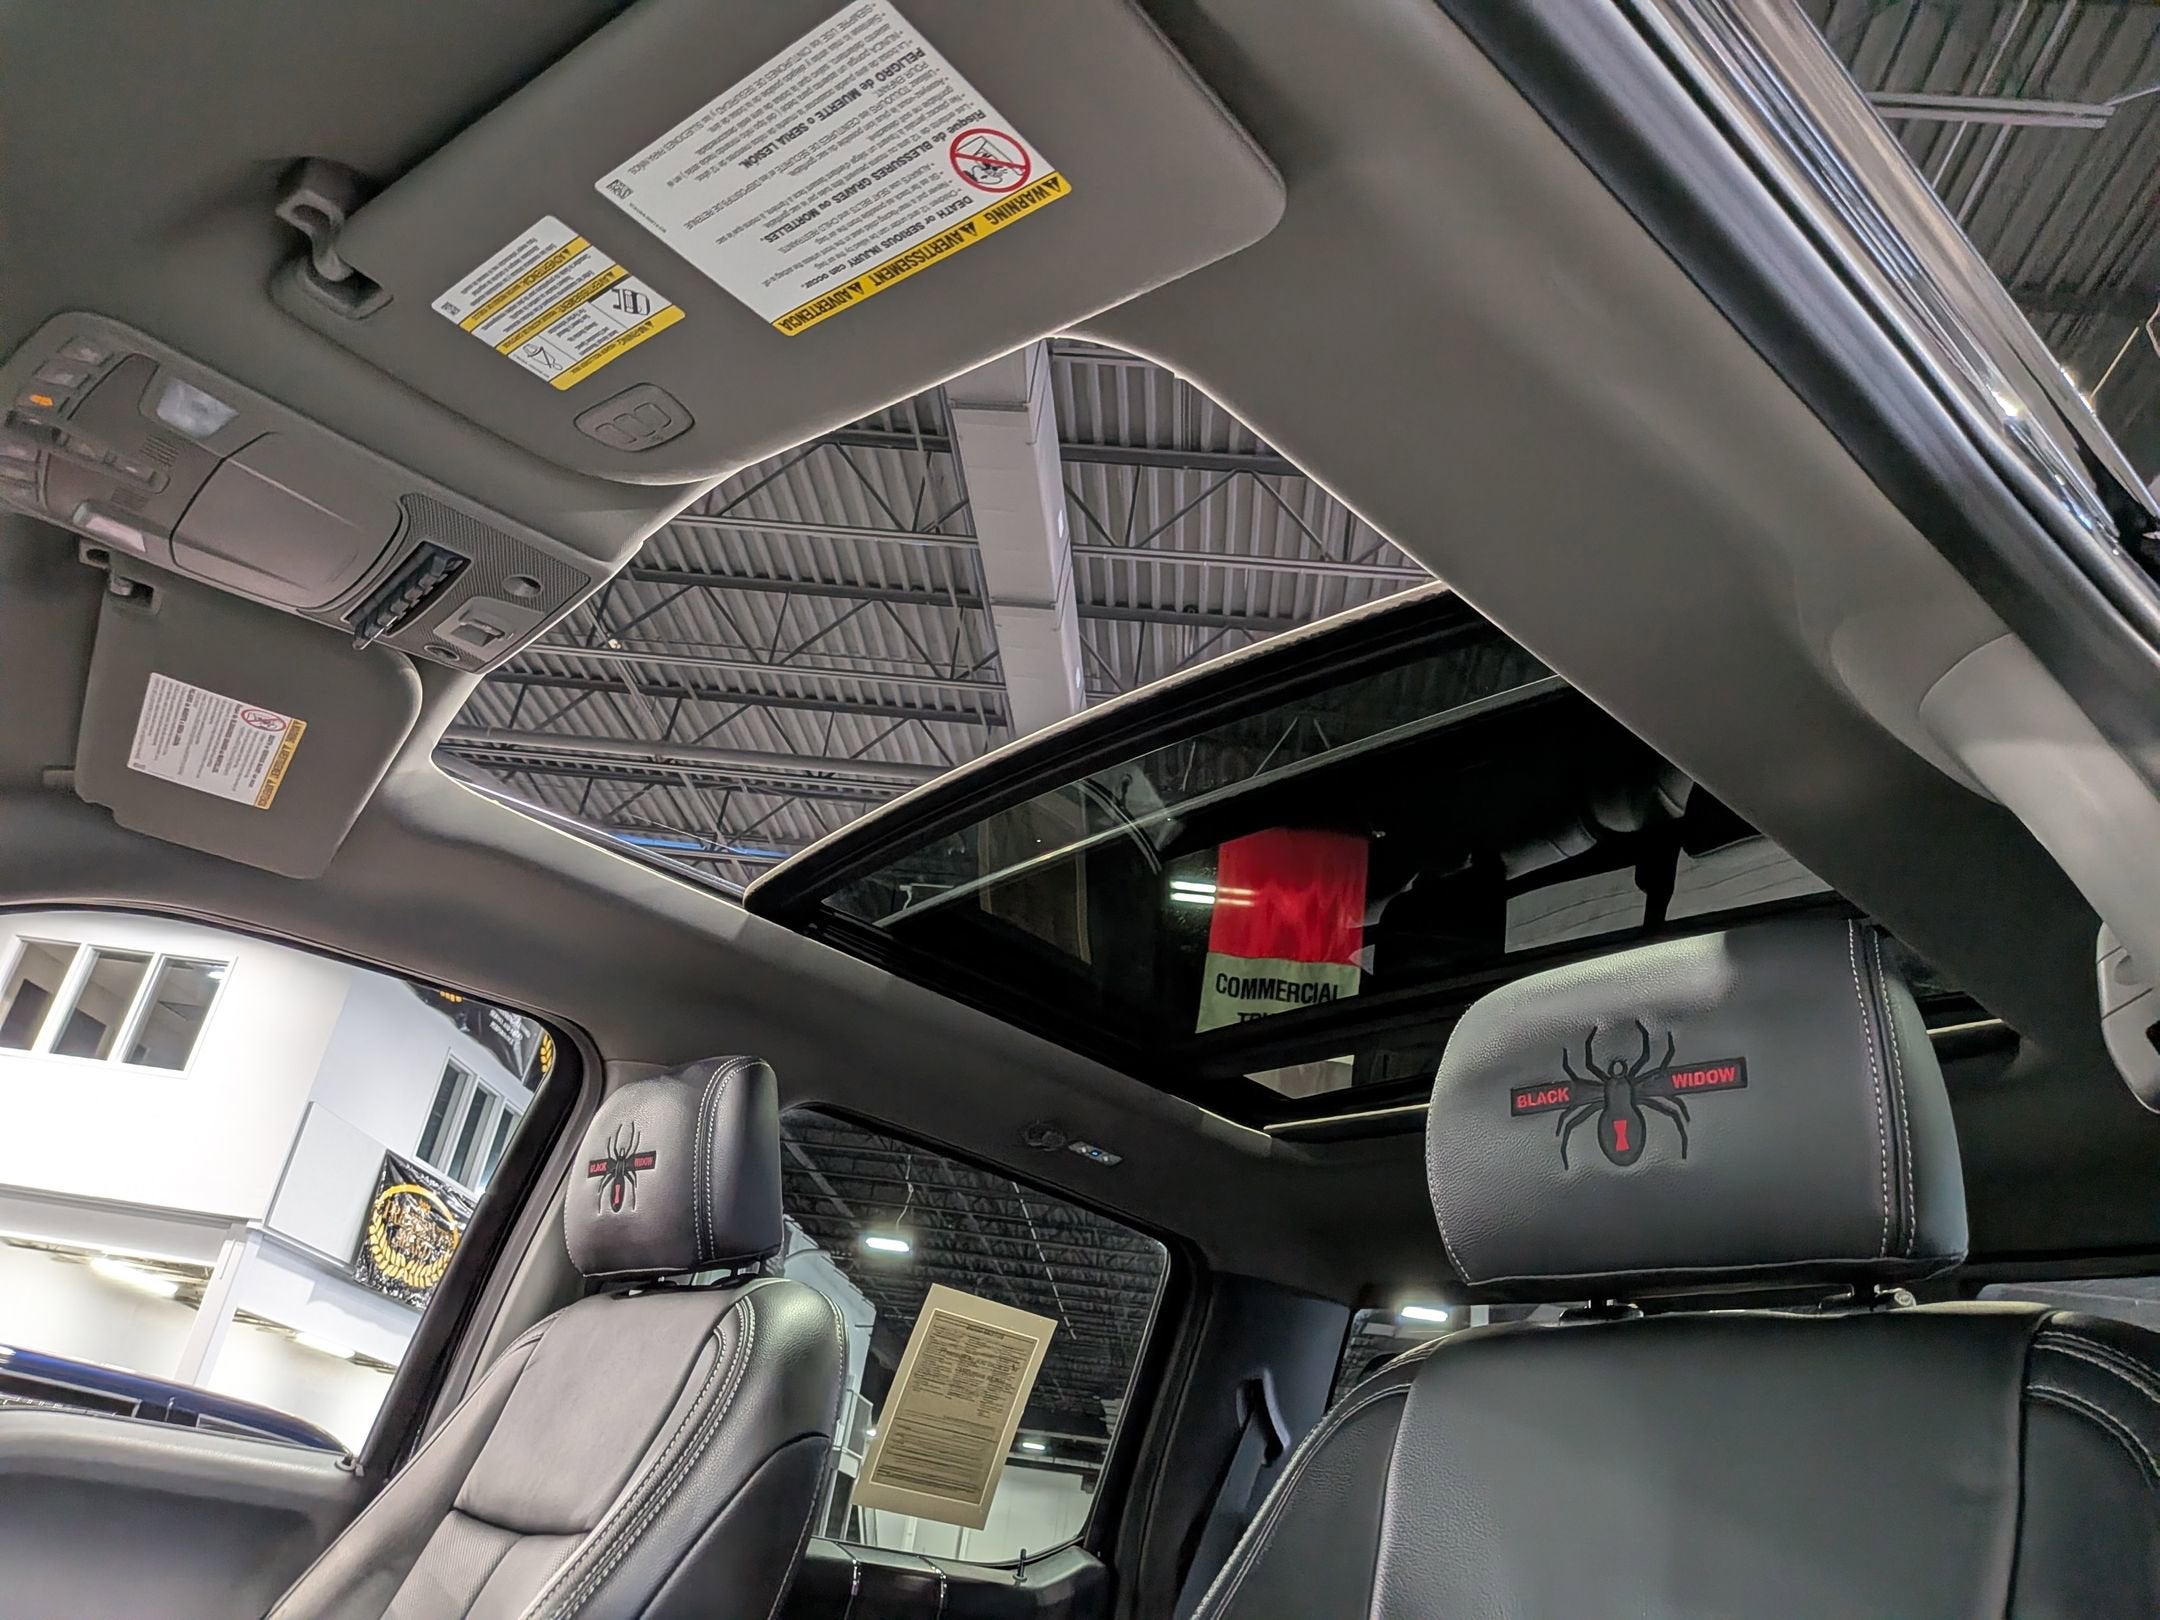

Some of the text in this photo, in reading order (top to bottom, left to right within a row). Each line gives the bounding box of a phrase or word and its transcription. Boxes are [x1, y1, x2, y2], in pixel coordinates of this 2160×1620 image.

[873, 46, 926, 82] PELIGRO
[858, 77, 877, 92] de
[813, 87, 862, 121] MUERTE
[775, 121, 810, 146] SERIA
[805, 116, 816, 125] o
[944, 107, 986, 135] Risque
[929, 130, 950, 145] de
[737, 141, 781, 172] LESIÓN.
[869, 140, 934, 181] BLESSURES
[830, 176, 873, 204] GRAVES
[817, 199, 833, 210] ou
[935, 195, 974, 218] DEATH
[758, 206, 820, 245] MORTELLES.
[922, 214, 937, 224] or
[879, 221, 925, 249] SERIOUS
[777, 184, 1049, 332] WARNING AVERTISSEMENT ADVERTENCIA
[827, 263, 847, 275] can
[844, 244, 882, 267] INJURY
[1215, 973, 1338, 1004] COMMERCIAL
[1516, 1066, 1736, 1109] BLACK WIDOW
[590, 1161, 608, 1174] BLACK
